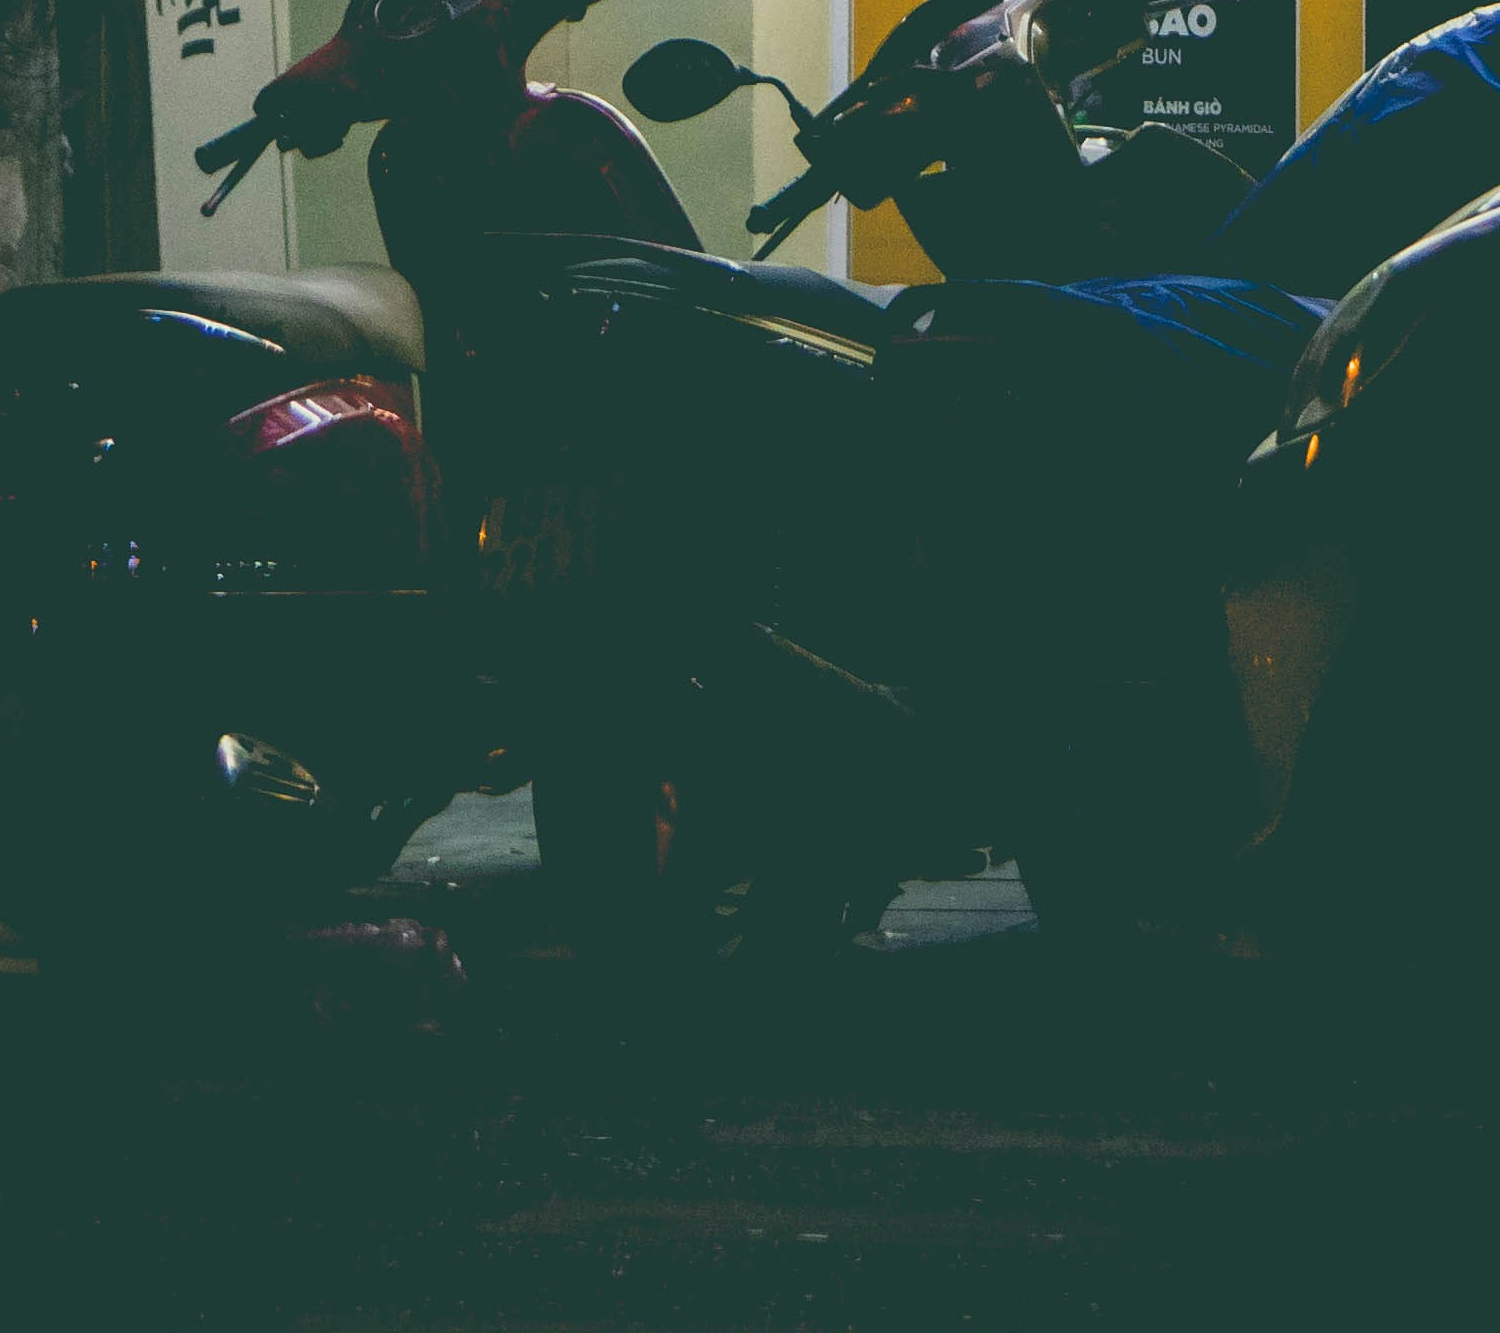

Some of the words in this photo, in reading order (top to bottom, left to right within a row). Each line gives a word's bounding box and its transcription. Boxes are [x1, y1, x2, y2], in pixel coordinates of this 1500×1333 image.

[1142, 47, 1183, 65] BUN
[1193, 97, 1222, 115] GIÒ
[1213, 123, 1275, 134] PYRAMIDAL
